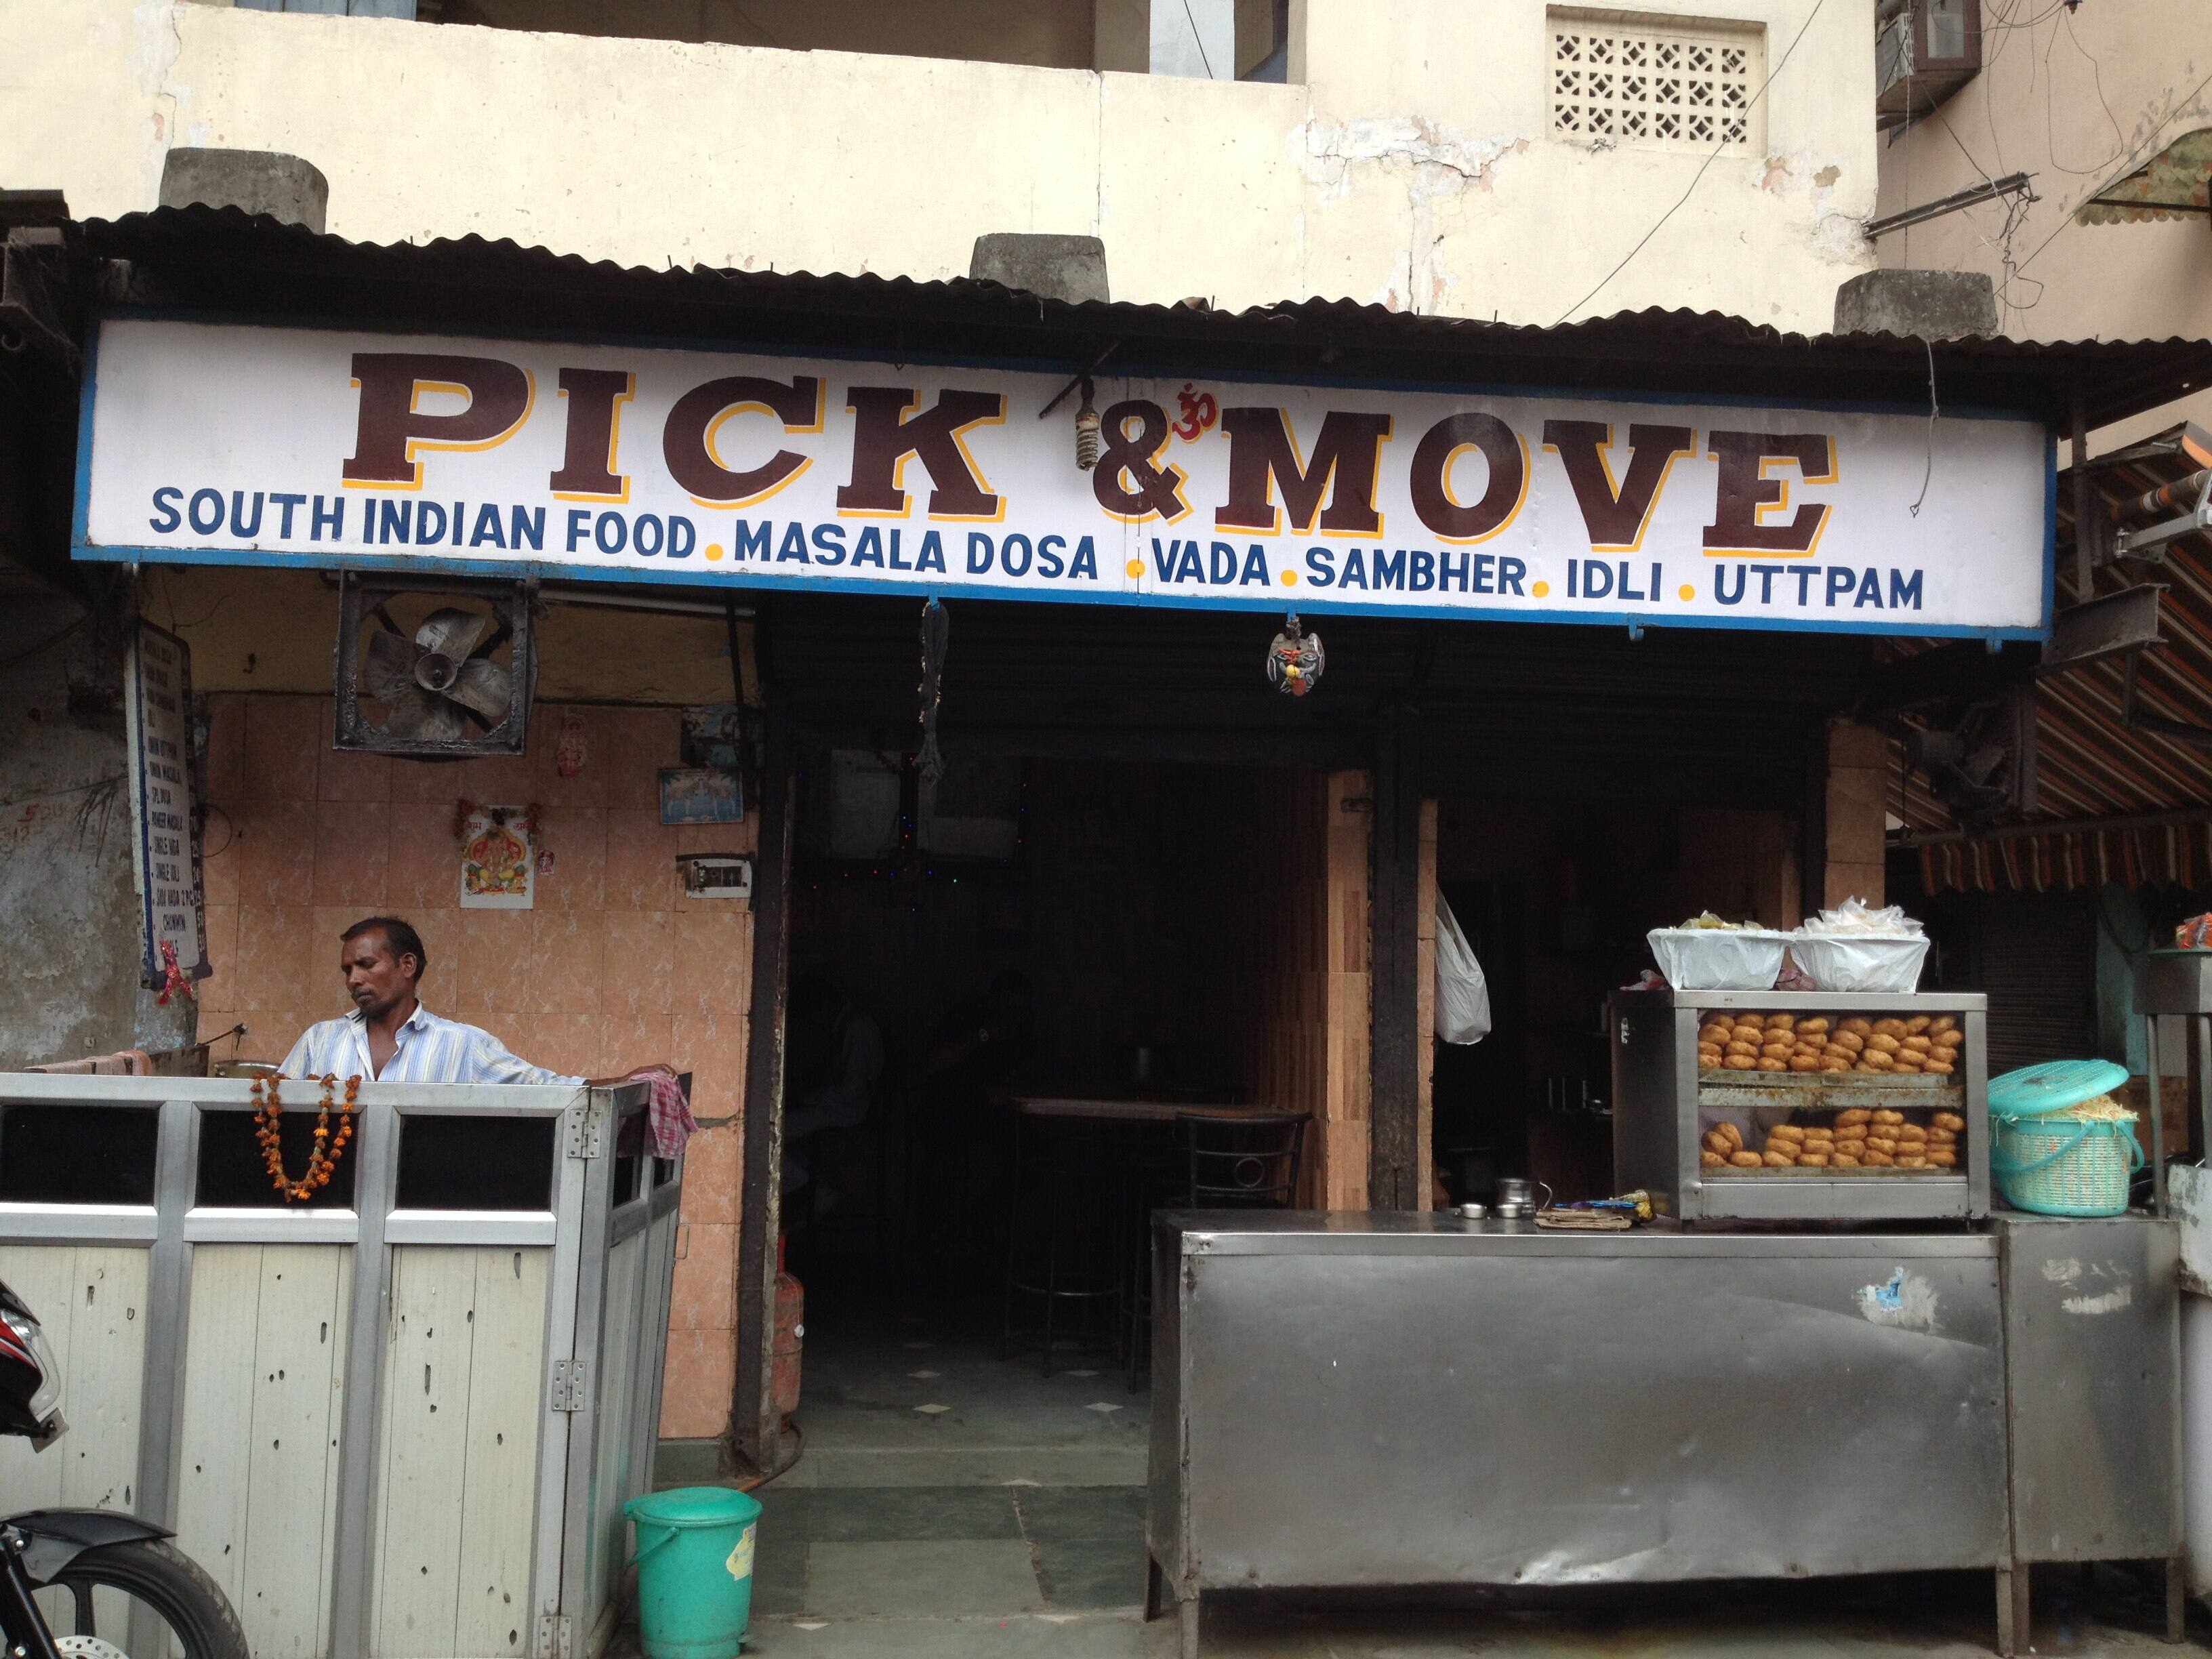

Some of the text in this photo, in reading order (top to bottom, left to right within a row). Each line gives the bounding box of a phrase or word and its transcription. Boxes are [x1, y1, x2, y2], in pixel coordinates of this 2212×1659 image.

[342, 352, 1839, 558] PICK & MOVE
[149, 487, 1923, 610] SOUTH INDIAN FOOD MASALA DOSA VADA SAMBHER IDLI UTTPAM
